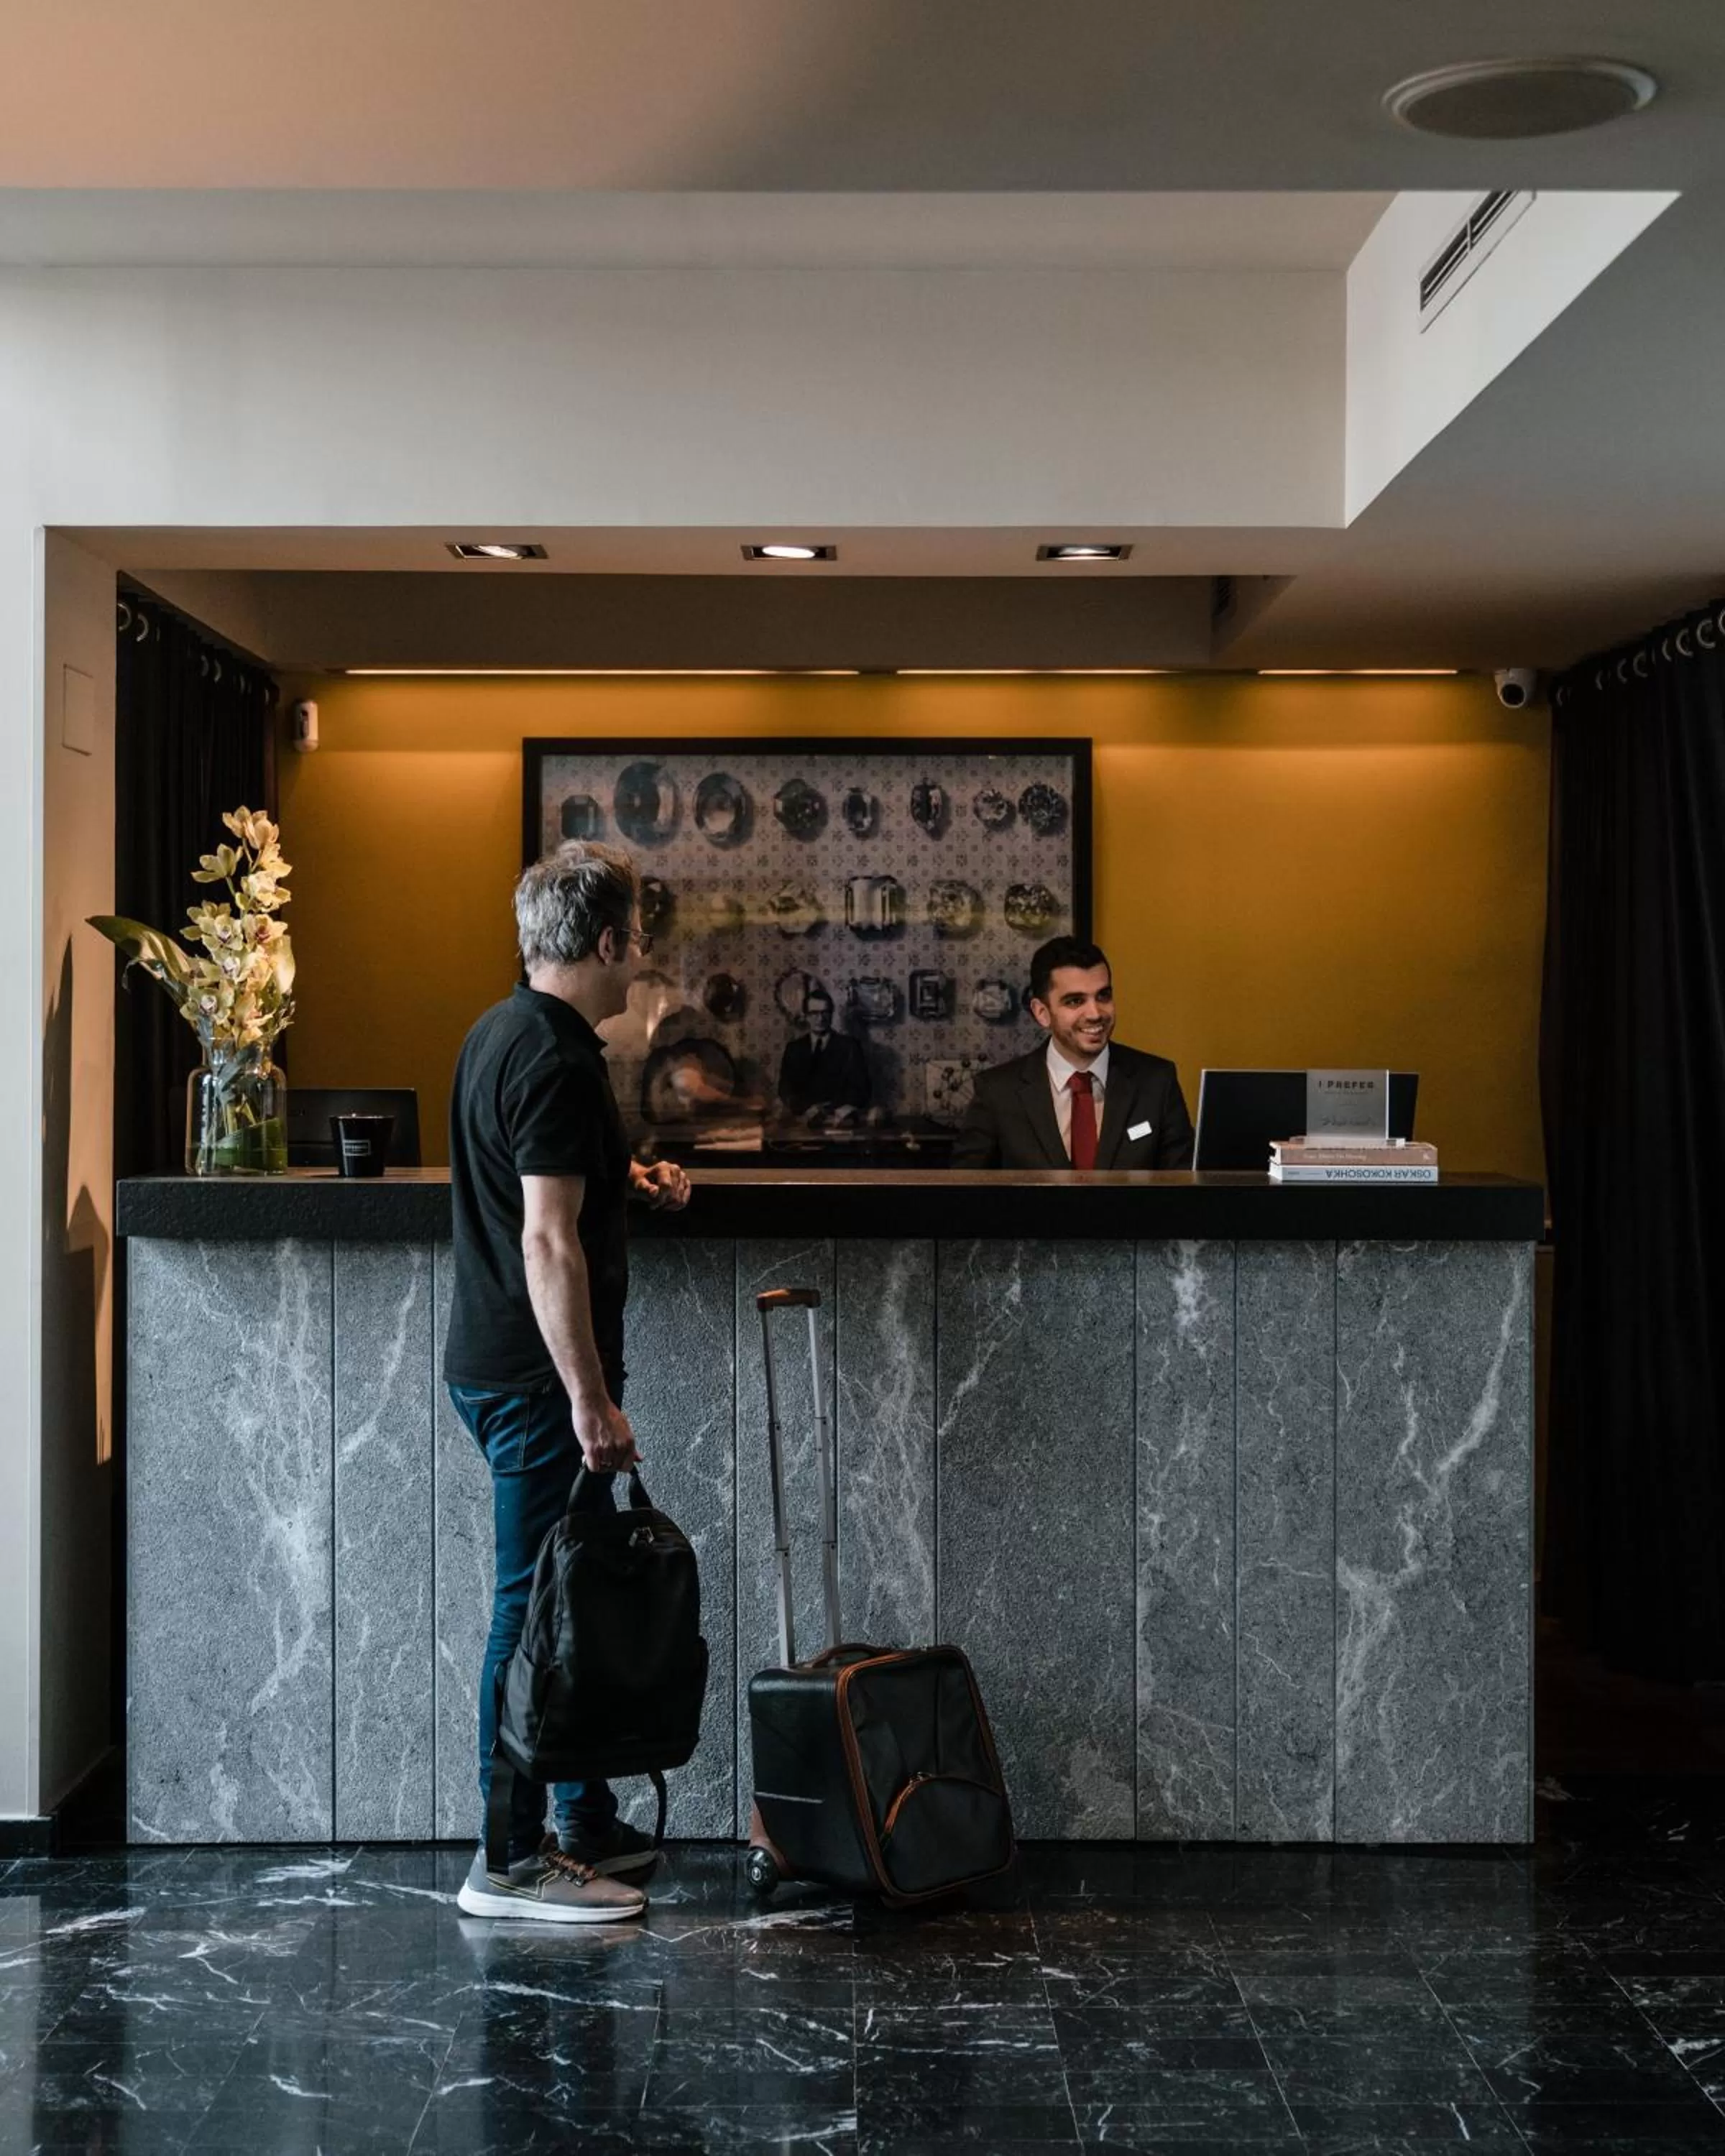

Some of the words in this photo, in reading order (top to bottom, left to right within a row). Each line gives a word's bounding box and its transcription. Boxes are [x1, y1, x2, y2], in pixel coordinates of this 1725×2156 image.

[1328, 1080, 1374, 1089] PREFER
[1325, 1169, 1392, 1179] KOKOSCHKA
[1394, 1169, 1431, 1179] OSKAR
